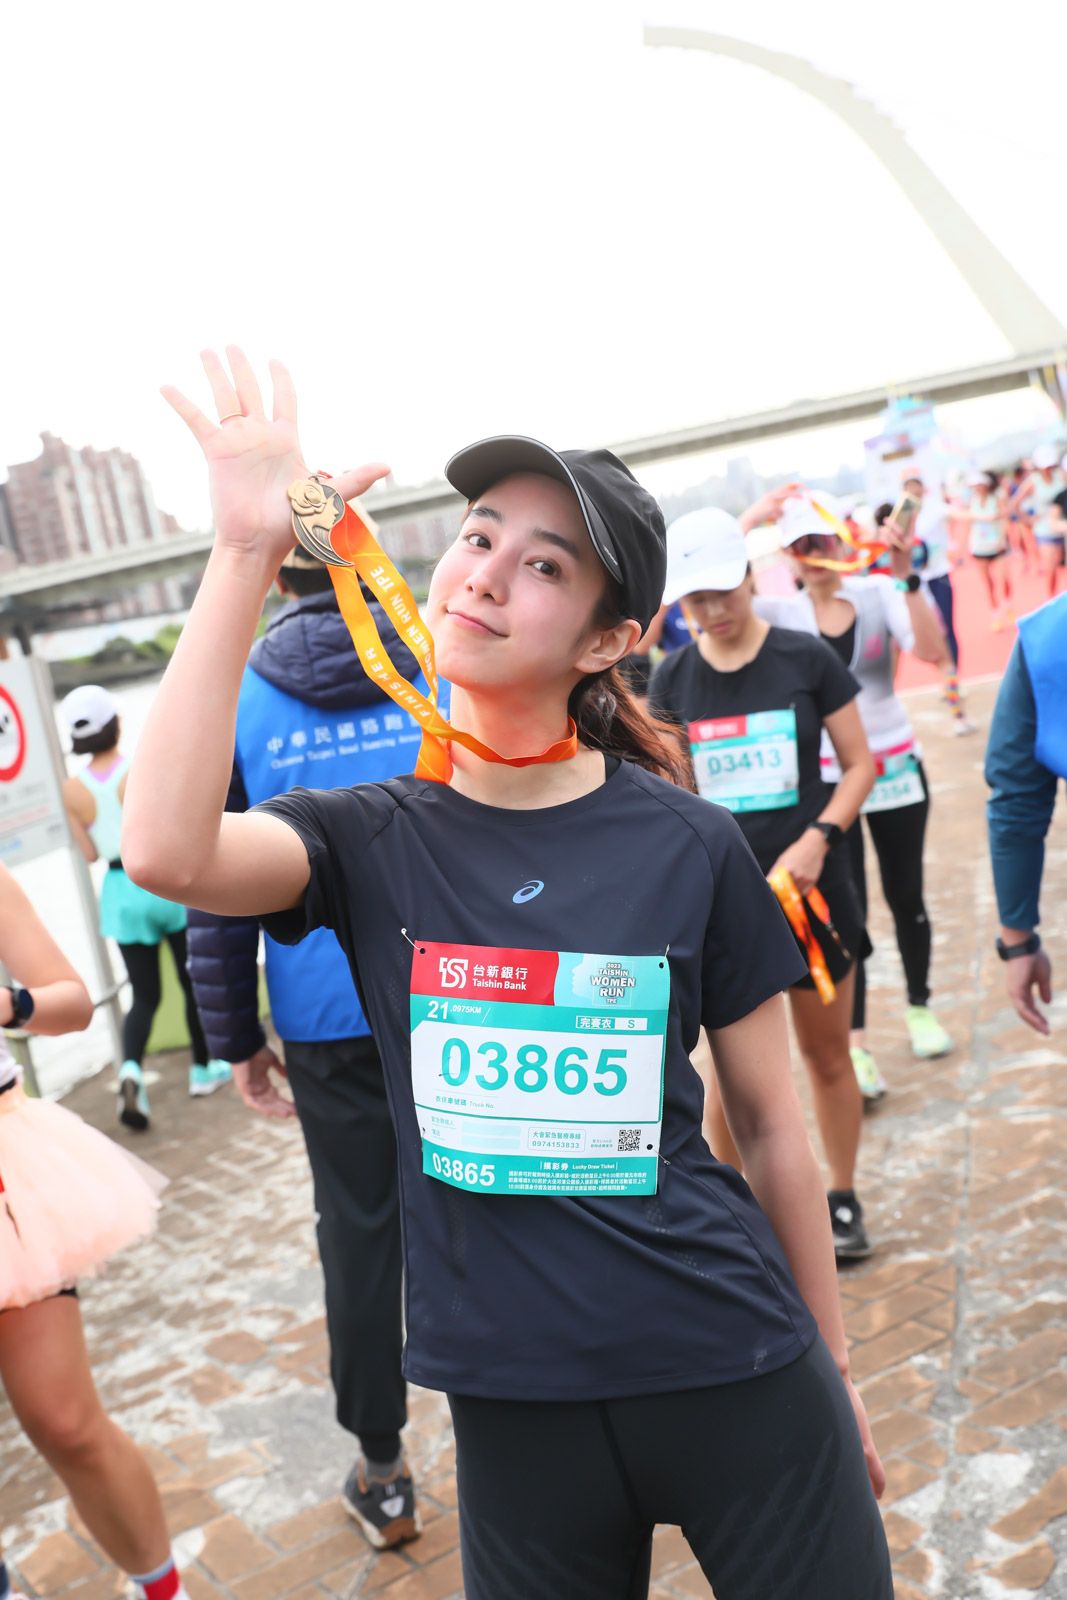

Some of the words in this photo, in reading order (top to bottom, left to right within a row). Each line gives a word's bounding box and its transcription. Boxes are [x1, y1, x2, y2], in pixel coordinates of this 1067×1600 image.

[370, 565, 395, 593] TPE
[389, 592, 412, 624] RUN
[364, 647, 432, 718] FINISHER
[707, 747, 782, 775] 03413
[473, 964, 528, 980] 台新銀行
[598, 968, 629, 976] TAISHIN
[472, 978, 503, 989] Taishin
[504, 981, 527, 991] Bank
[591, 976, 636, 987] WOMEN
[599, 988, 625, 997] RUN
[580, 1017, 612, 1029] 完賽衣
[628, 1019, 635, 1029] S
[441, 1037, 628, 1097] 03865
[469, 1100, 484, 1108] Truck
[531, 1140, 580, 1149] 0974153833
[432, 1152, 496, 1187] 03865
